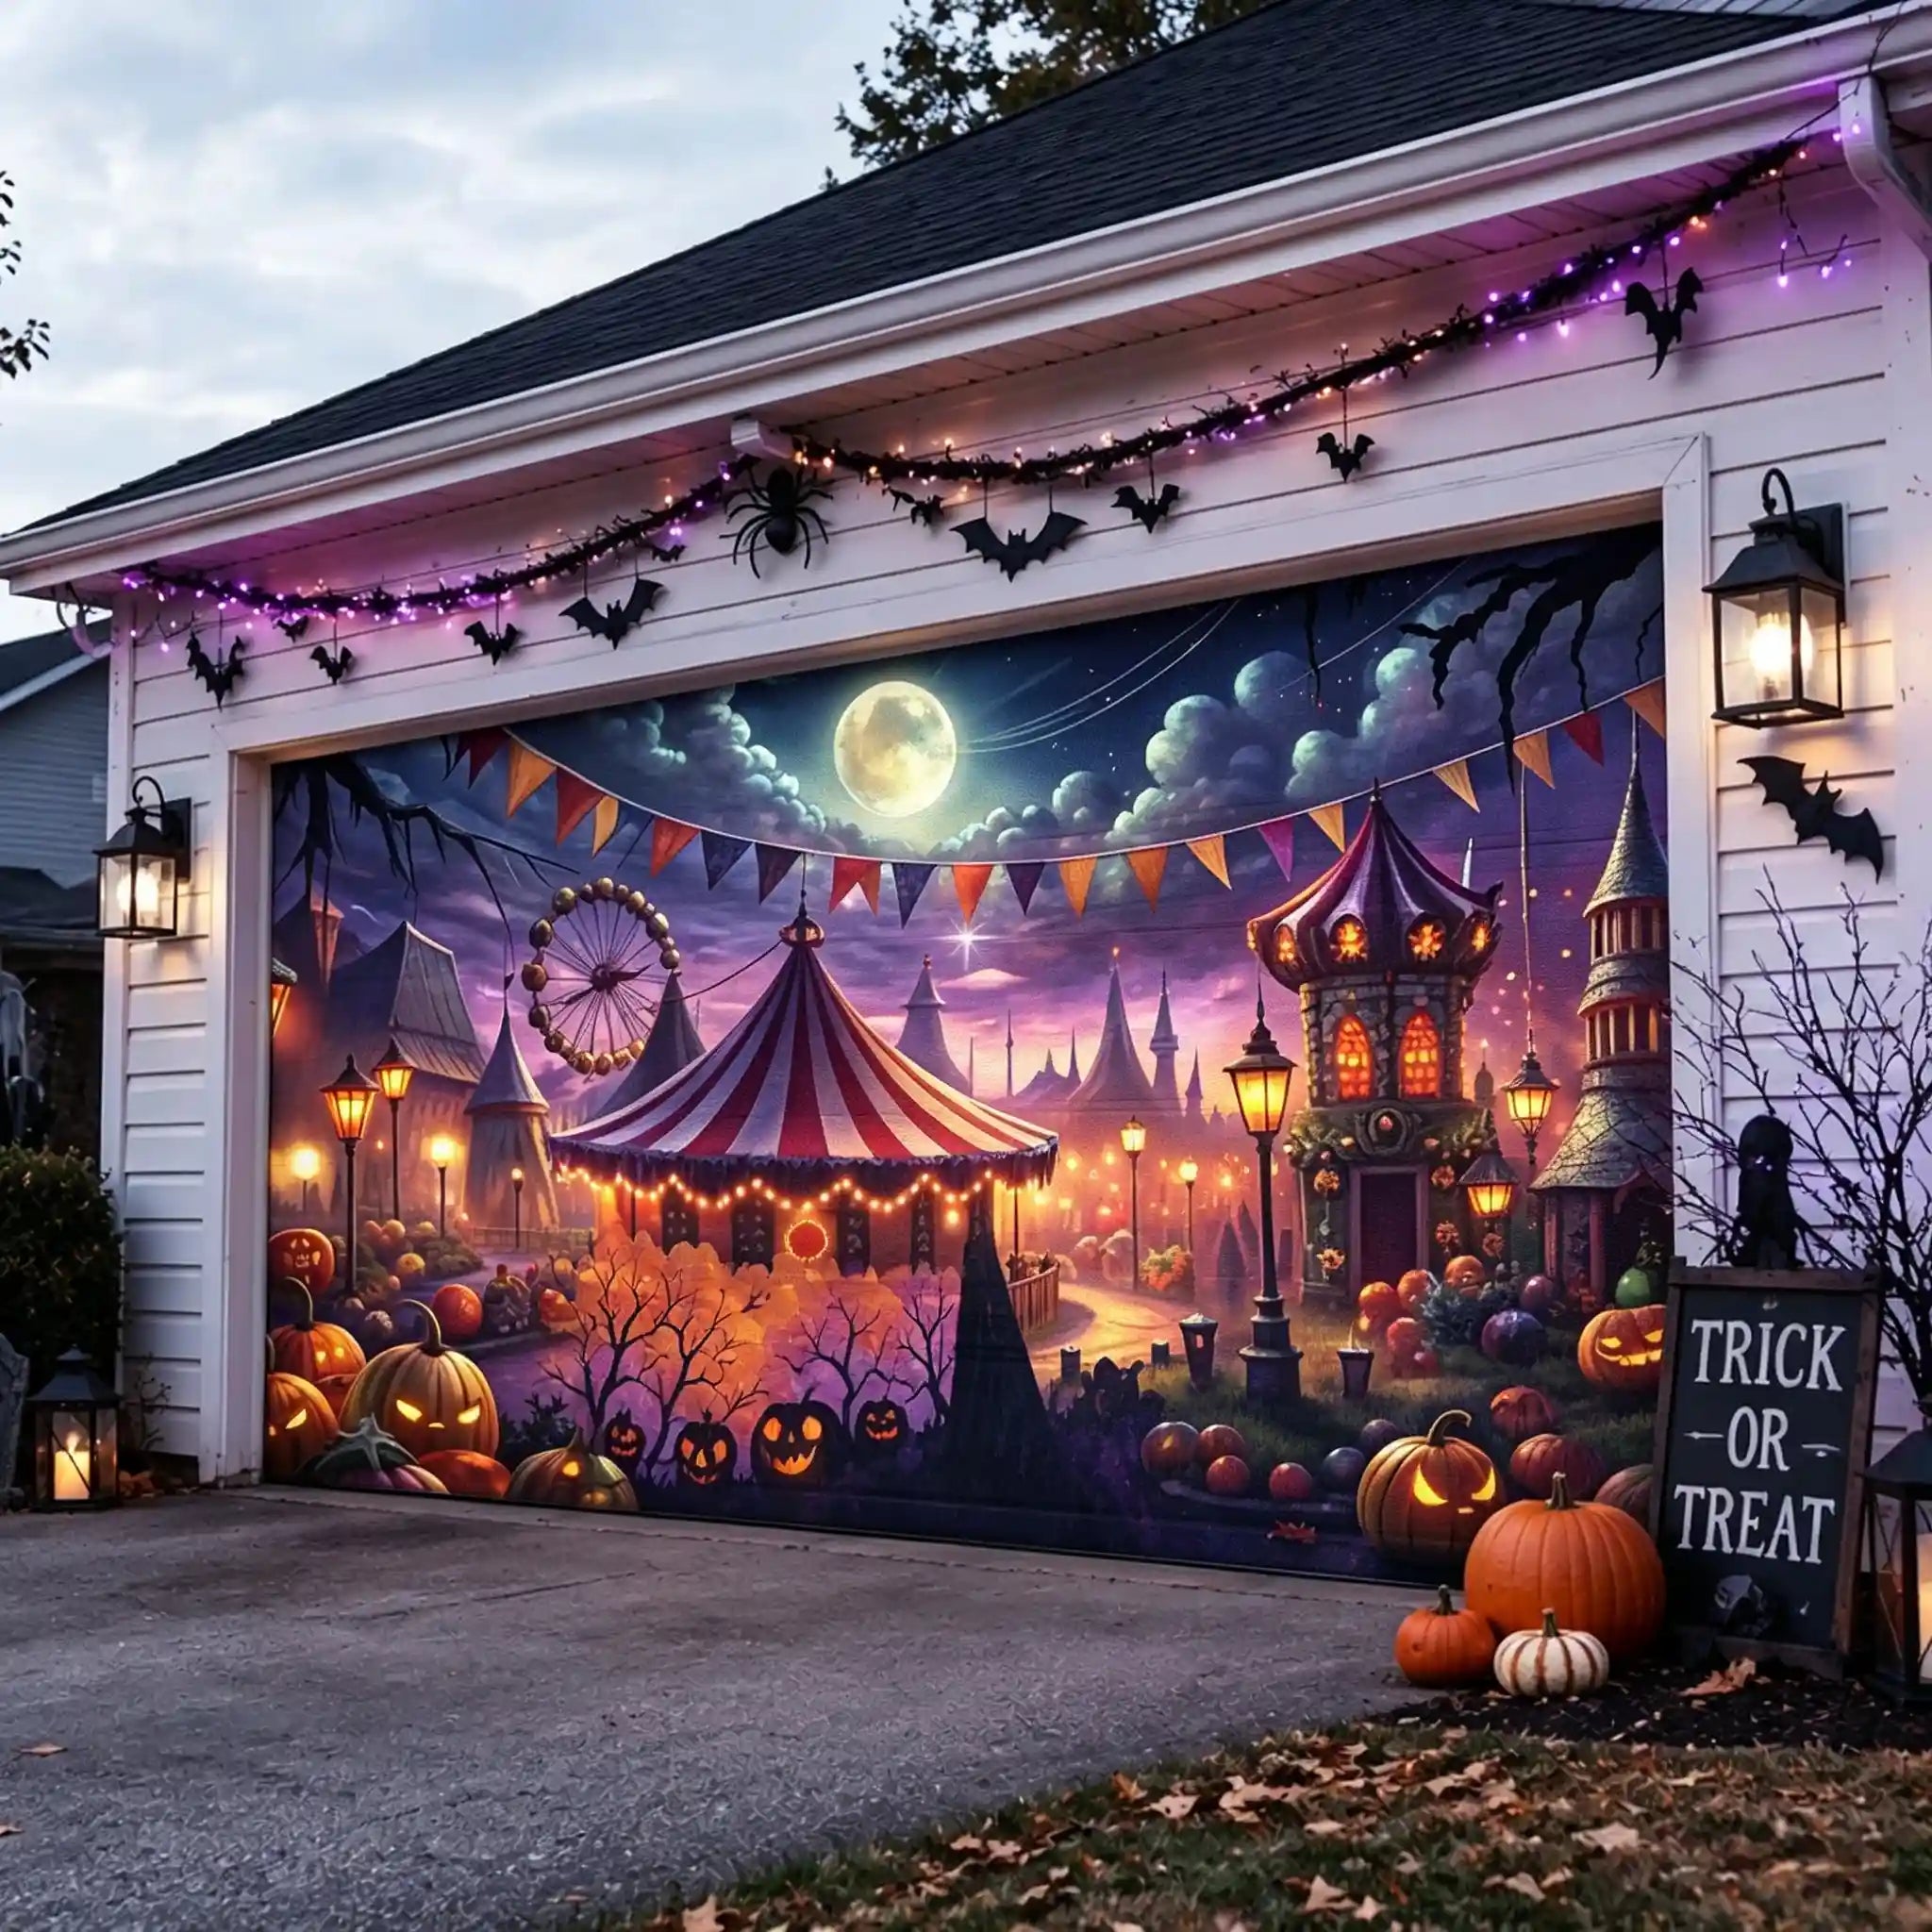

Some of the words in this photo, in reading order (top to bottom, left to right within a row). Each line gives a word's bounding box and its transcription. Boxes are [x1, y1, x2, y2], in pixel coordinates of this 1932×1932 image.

[1691, 1320, 1846, 1391] TRICK
[1727, 1406, 1790, 1472] OR
[1674, 1484, 1836, 1565] TREAT
